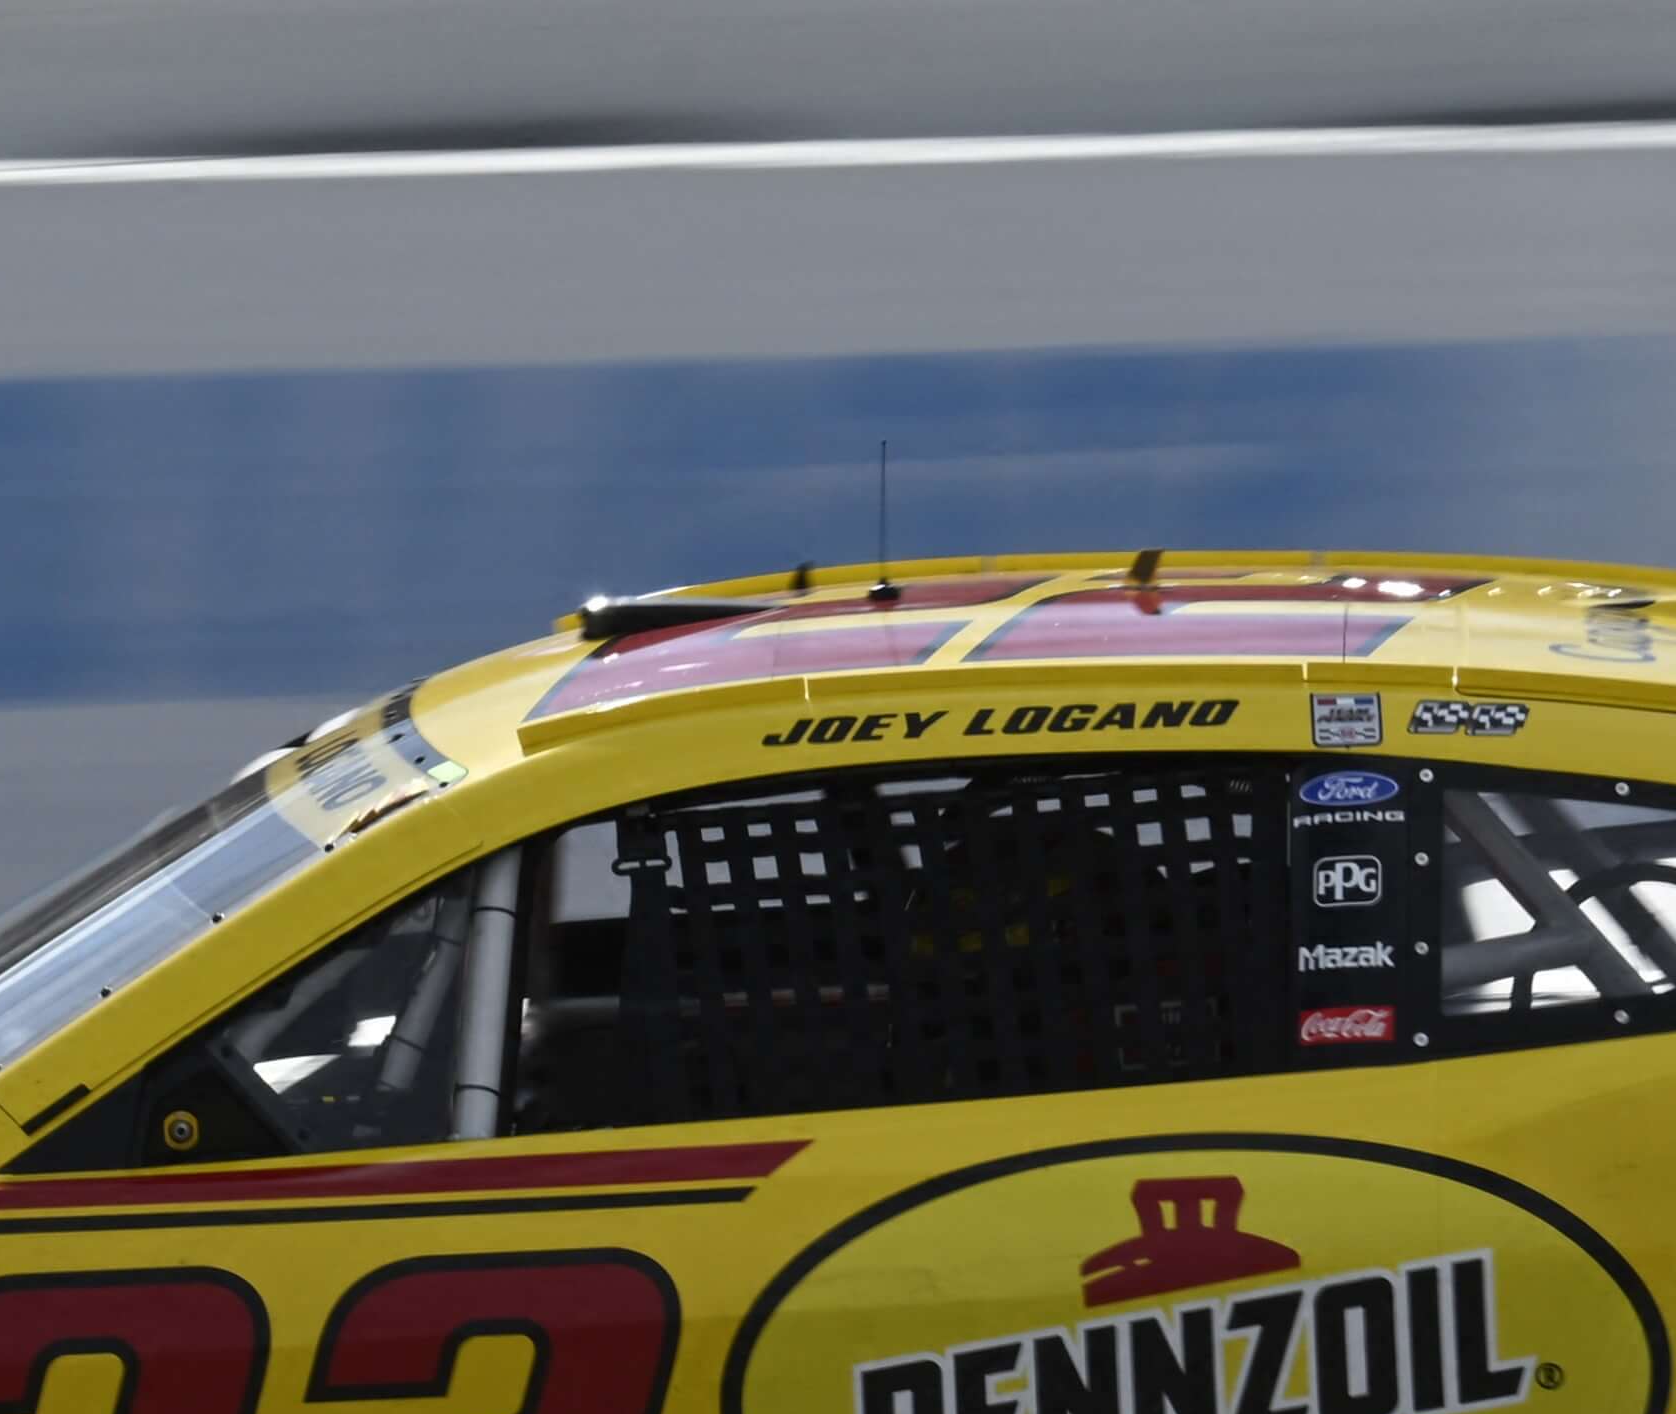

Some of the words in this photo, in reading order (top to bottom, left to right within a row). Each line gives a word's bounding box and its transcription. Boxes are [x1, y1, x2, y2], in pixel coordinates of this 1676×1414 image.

[761, 711, 949, 746] JOEY
[962, 699, 1239, 736] LOGANO
[1318, 777, 1379, 801] Ford
[1293, 810, 1405, 828] RACING
[1318, 861, 1377, 900] PPG
[1298, 941, 1395, 972] Mazak
